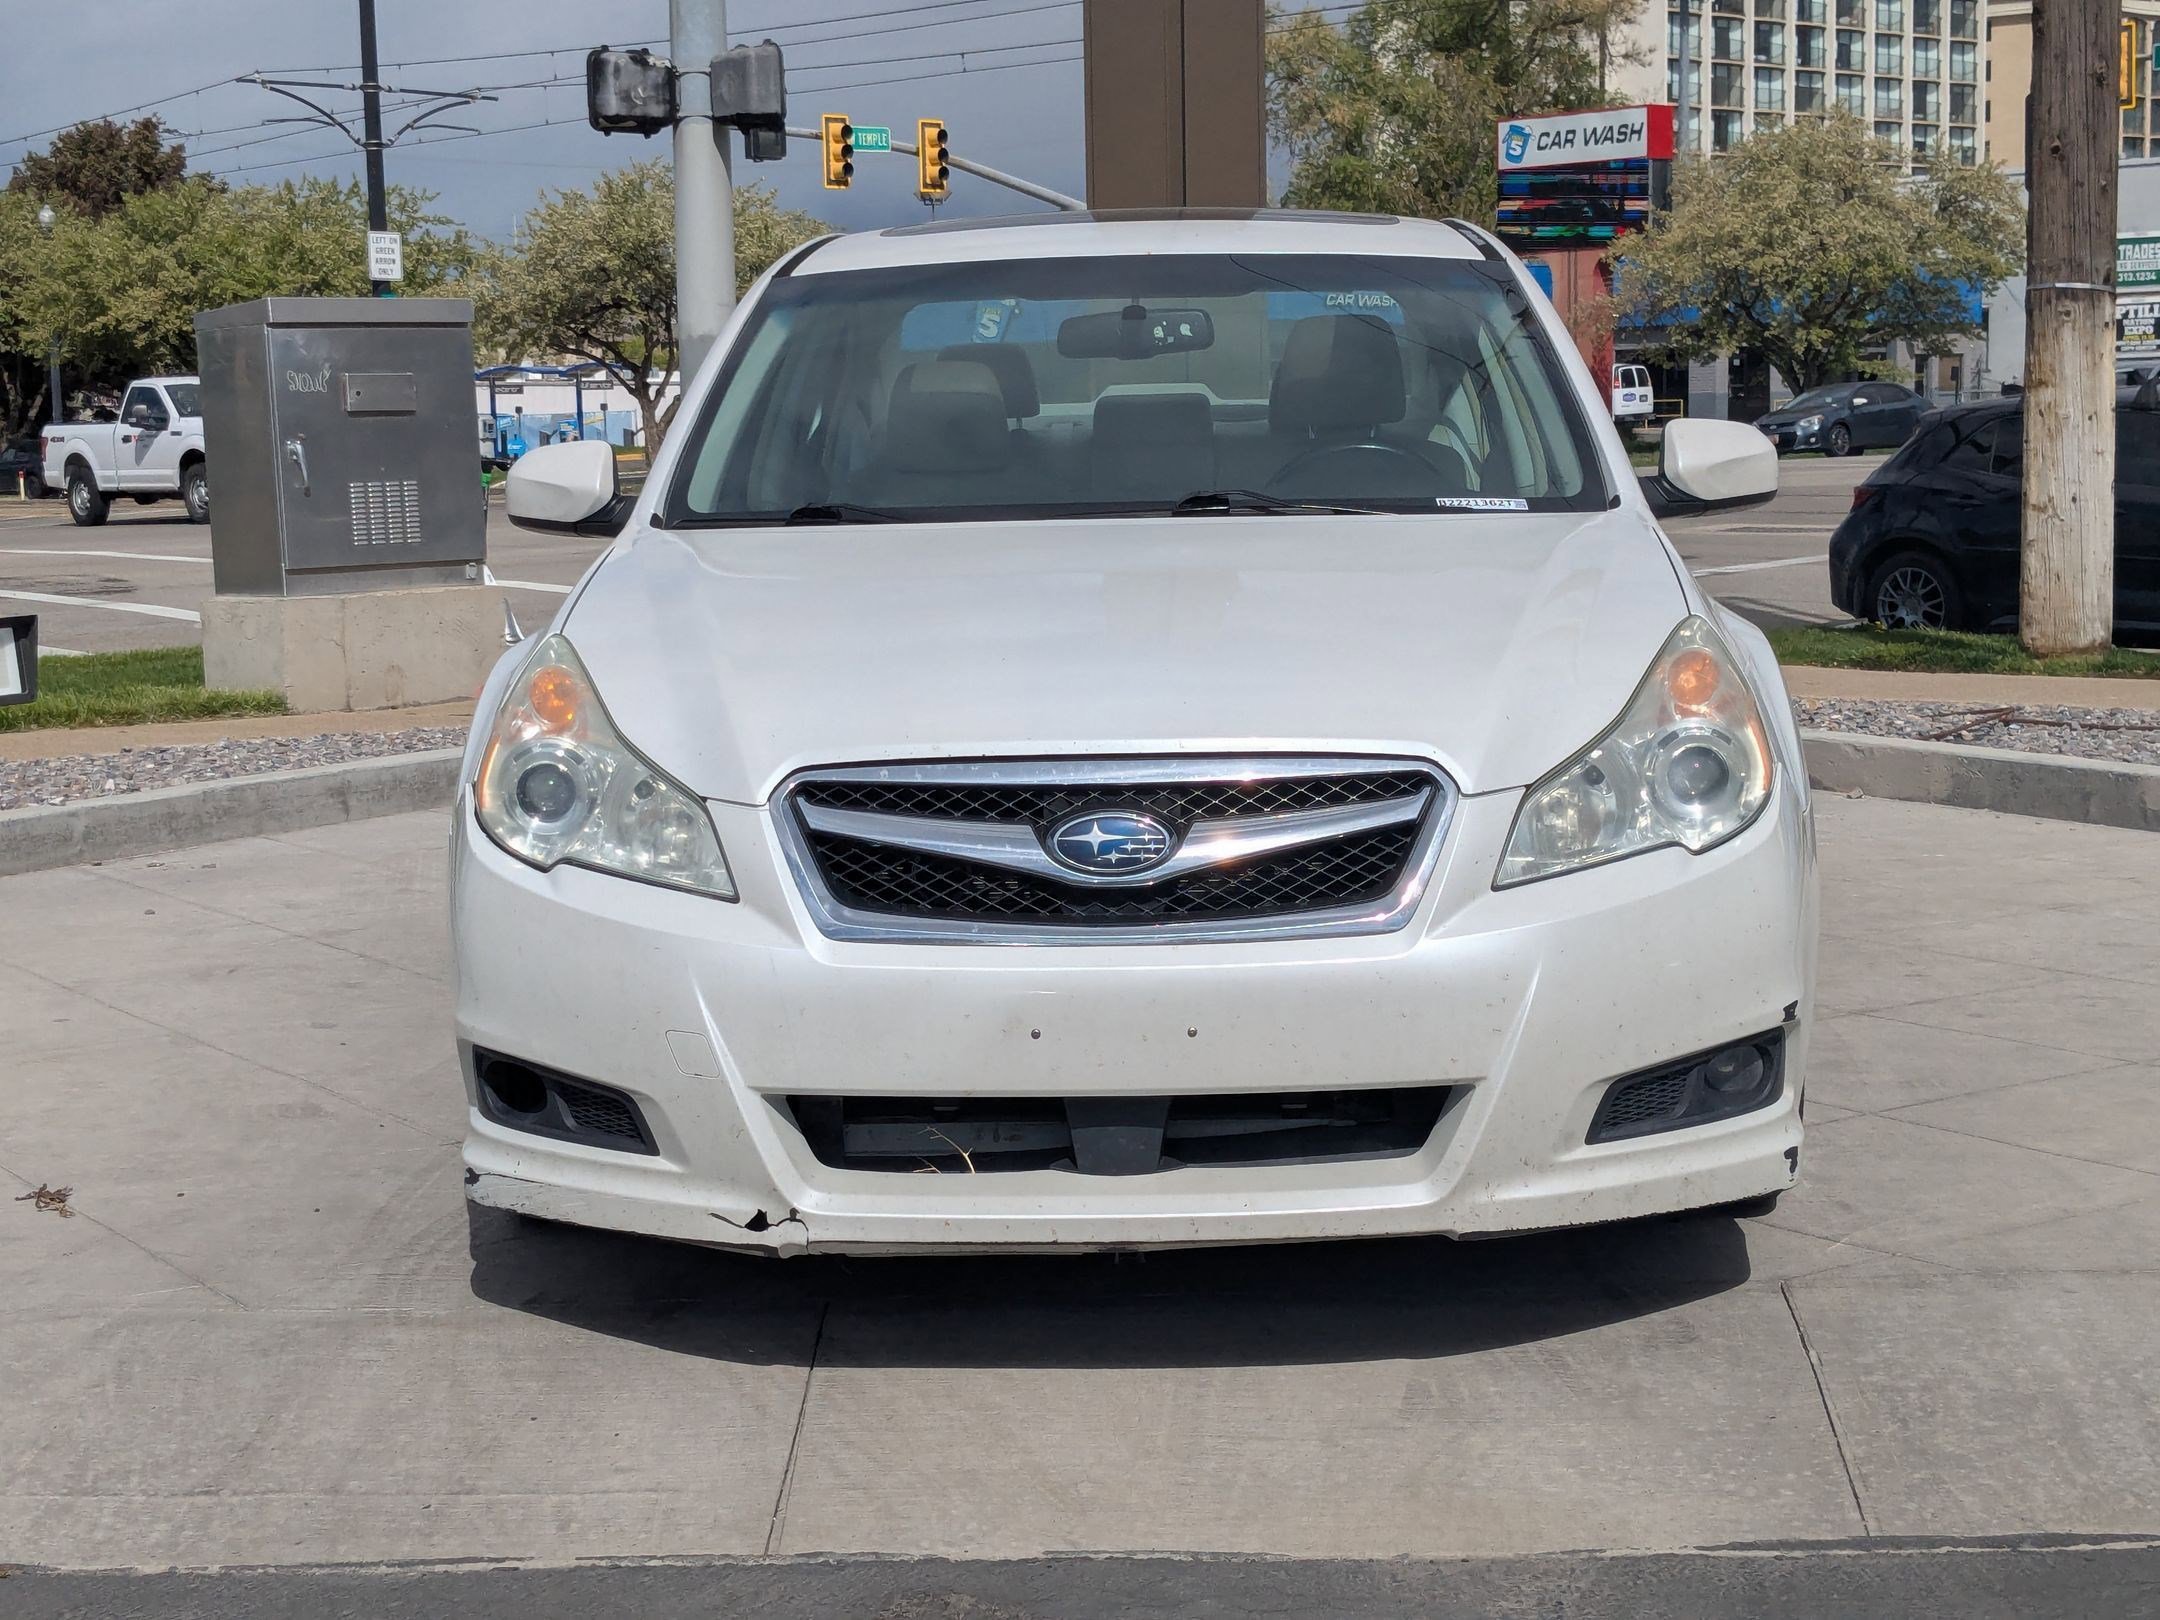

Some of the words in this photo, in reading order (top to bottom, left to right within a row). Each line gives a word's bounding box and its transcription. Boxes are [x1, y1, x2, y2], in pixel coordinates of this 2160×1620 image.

[858, 133, 888, 146] TEMPLE
[1537, 130, 1576, 151] CAR
[1583, 122, 1644, 147] WASH
[1508, 140, 1523, 156] 5
[372, 236, 386, 244] LEFT
[375, 247, 395, 255] GREEN
[378, 268, 394, 276] ONLY
[1326, 294, 1355, 306] CAR
